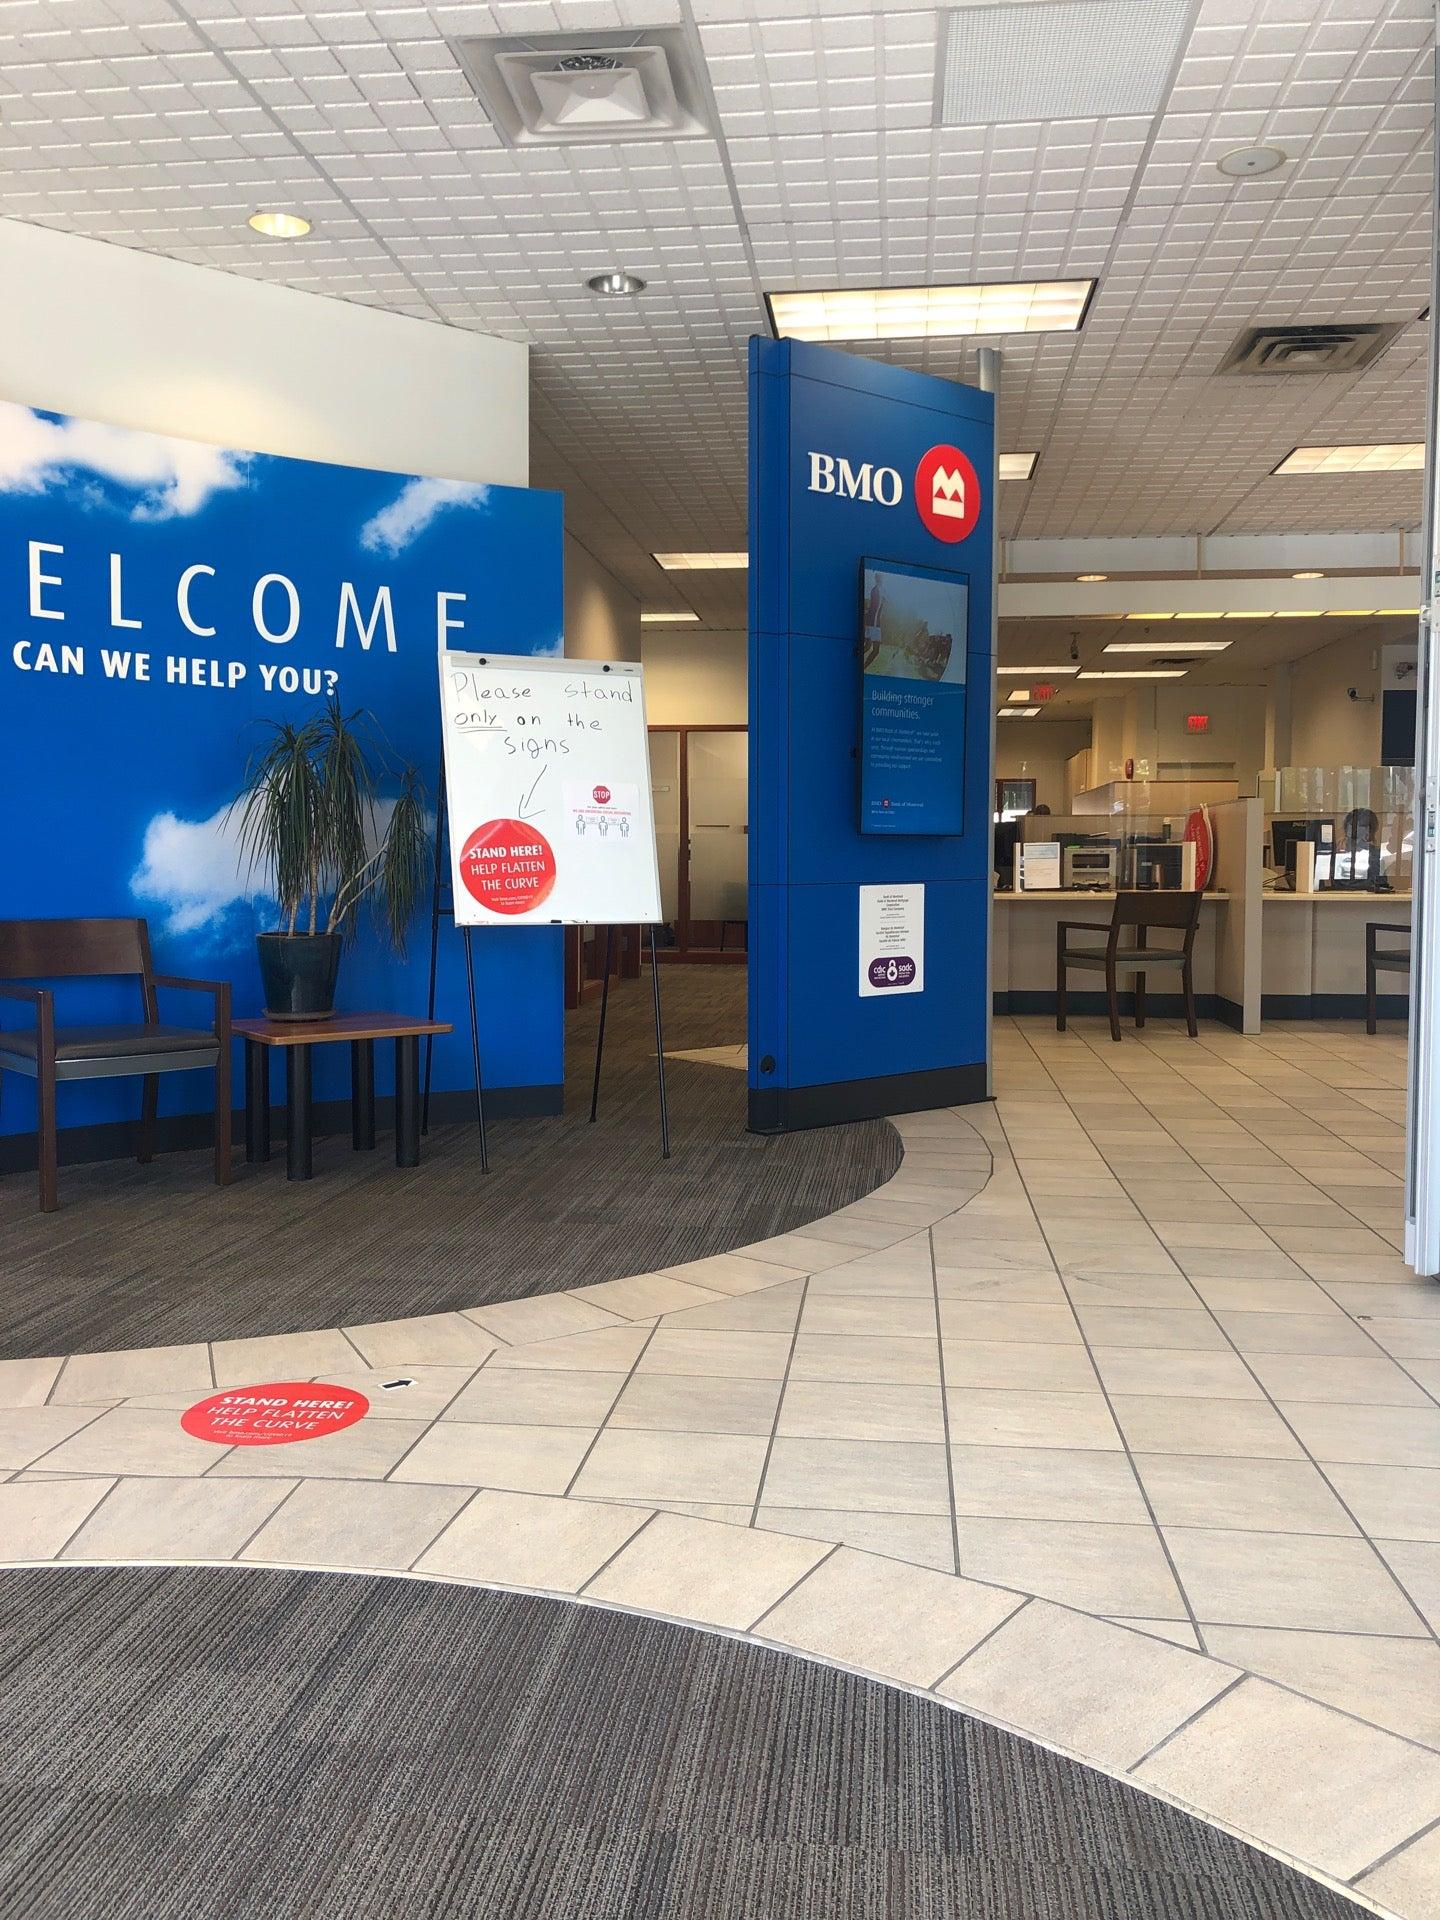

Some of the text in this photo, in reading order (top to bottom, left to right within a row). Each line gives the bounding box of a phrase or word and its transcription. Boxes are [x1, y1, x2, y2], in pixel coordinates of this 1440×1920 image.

[808, 452, 903, 506] BMO
[12, 640, 339, 695] CAN WE HELP YOU?
[451, 672, 633, 703] Please stand
[872, 690, 934, 708] Building stronger
[454, 709, 602, 731] only on the
[872, 707, 920, 719] communities.
[504, 737, 570, 759] signs
[593, 790, 610, 799] STOP
[470, 845, 543, 859] STAND HERE!
[471, 861, 545, 875] HELP FLATTEN
[482, 877, 539, 891] THE CURVE
[220, 1396, 354, 1409] STAND HERE!
[207, 1406, 345, 1420] HELP FLATTEN
[210, 1417, 320, 1430] THE CURVE
